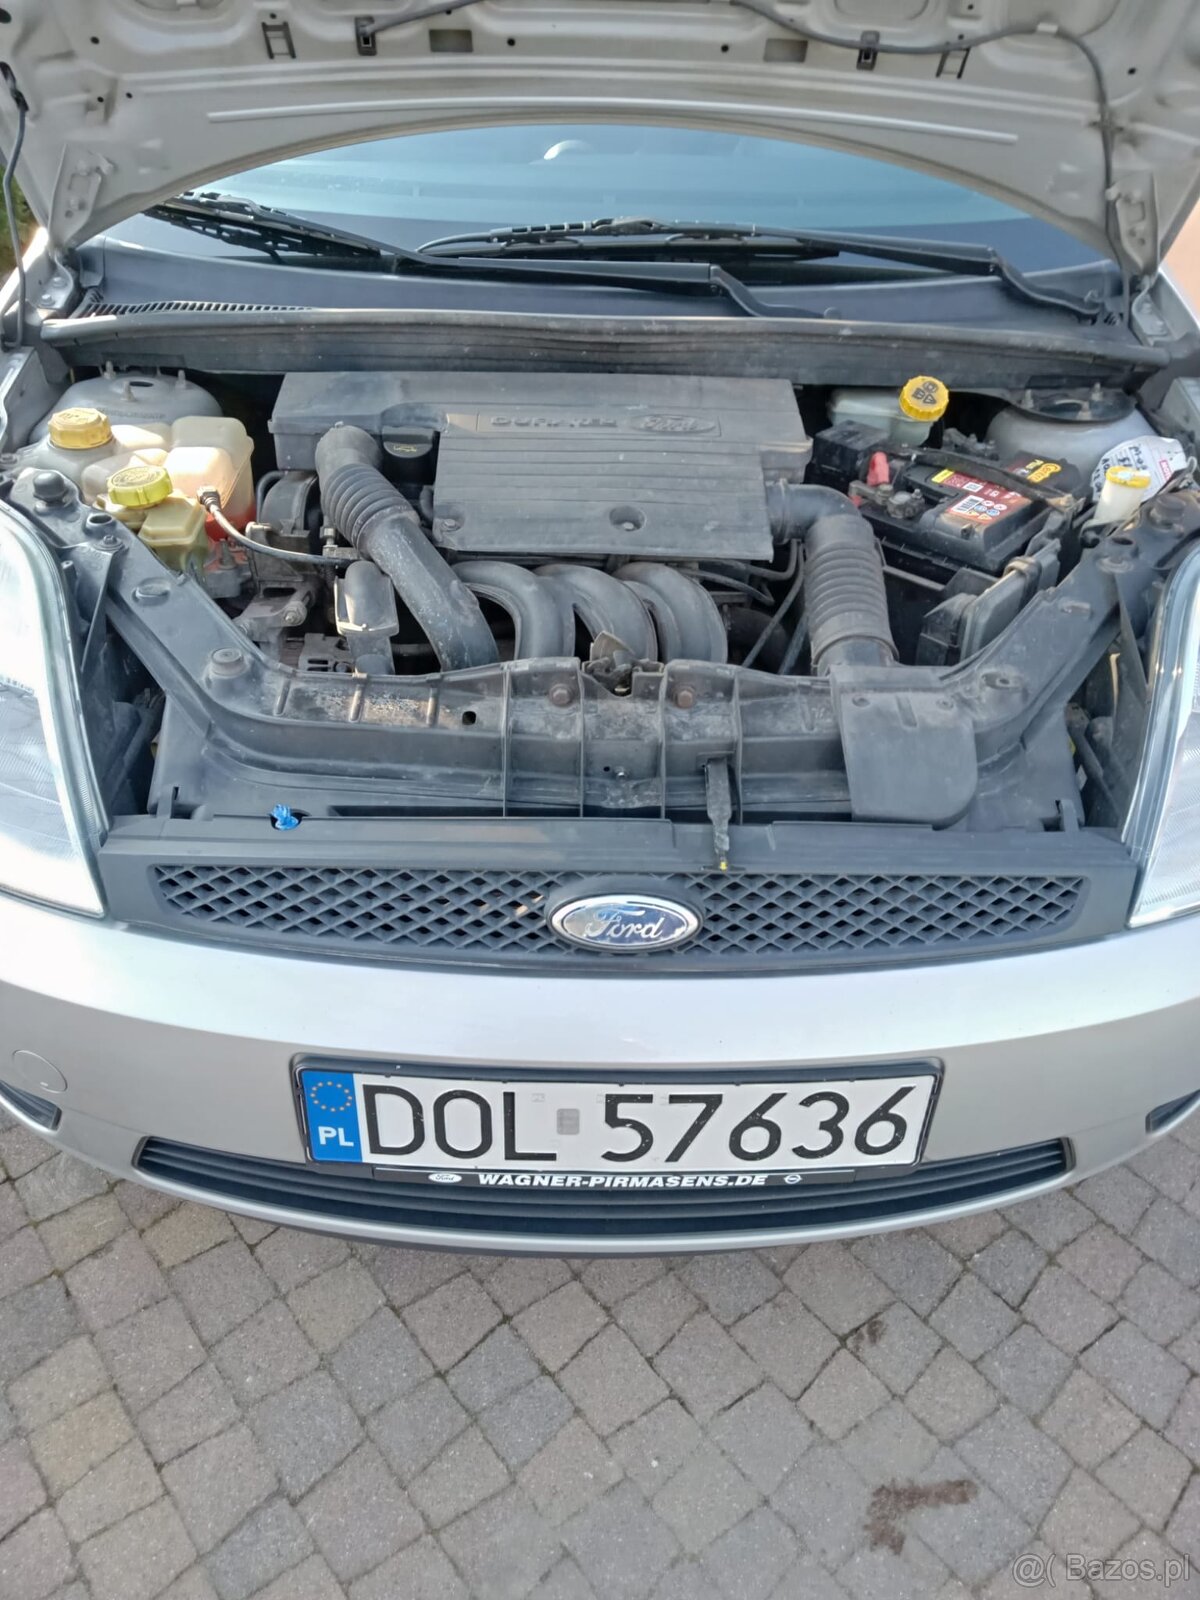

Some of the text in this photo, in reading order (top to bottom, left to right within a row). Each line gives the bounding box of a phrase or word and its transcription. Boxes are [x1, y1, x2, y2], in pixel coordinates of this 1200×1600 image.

[584, 907, 664, 938] Ford
[362, 1084, 557, 1160] DOL
[601, 1086, 916, 1162] 57636
[318, 1126, 354, 1147] PL
[478, 1173, 768, 1187] WAGNER-PIRMASENS.DE
